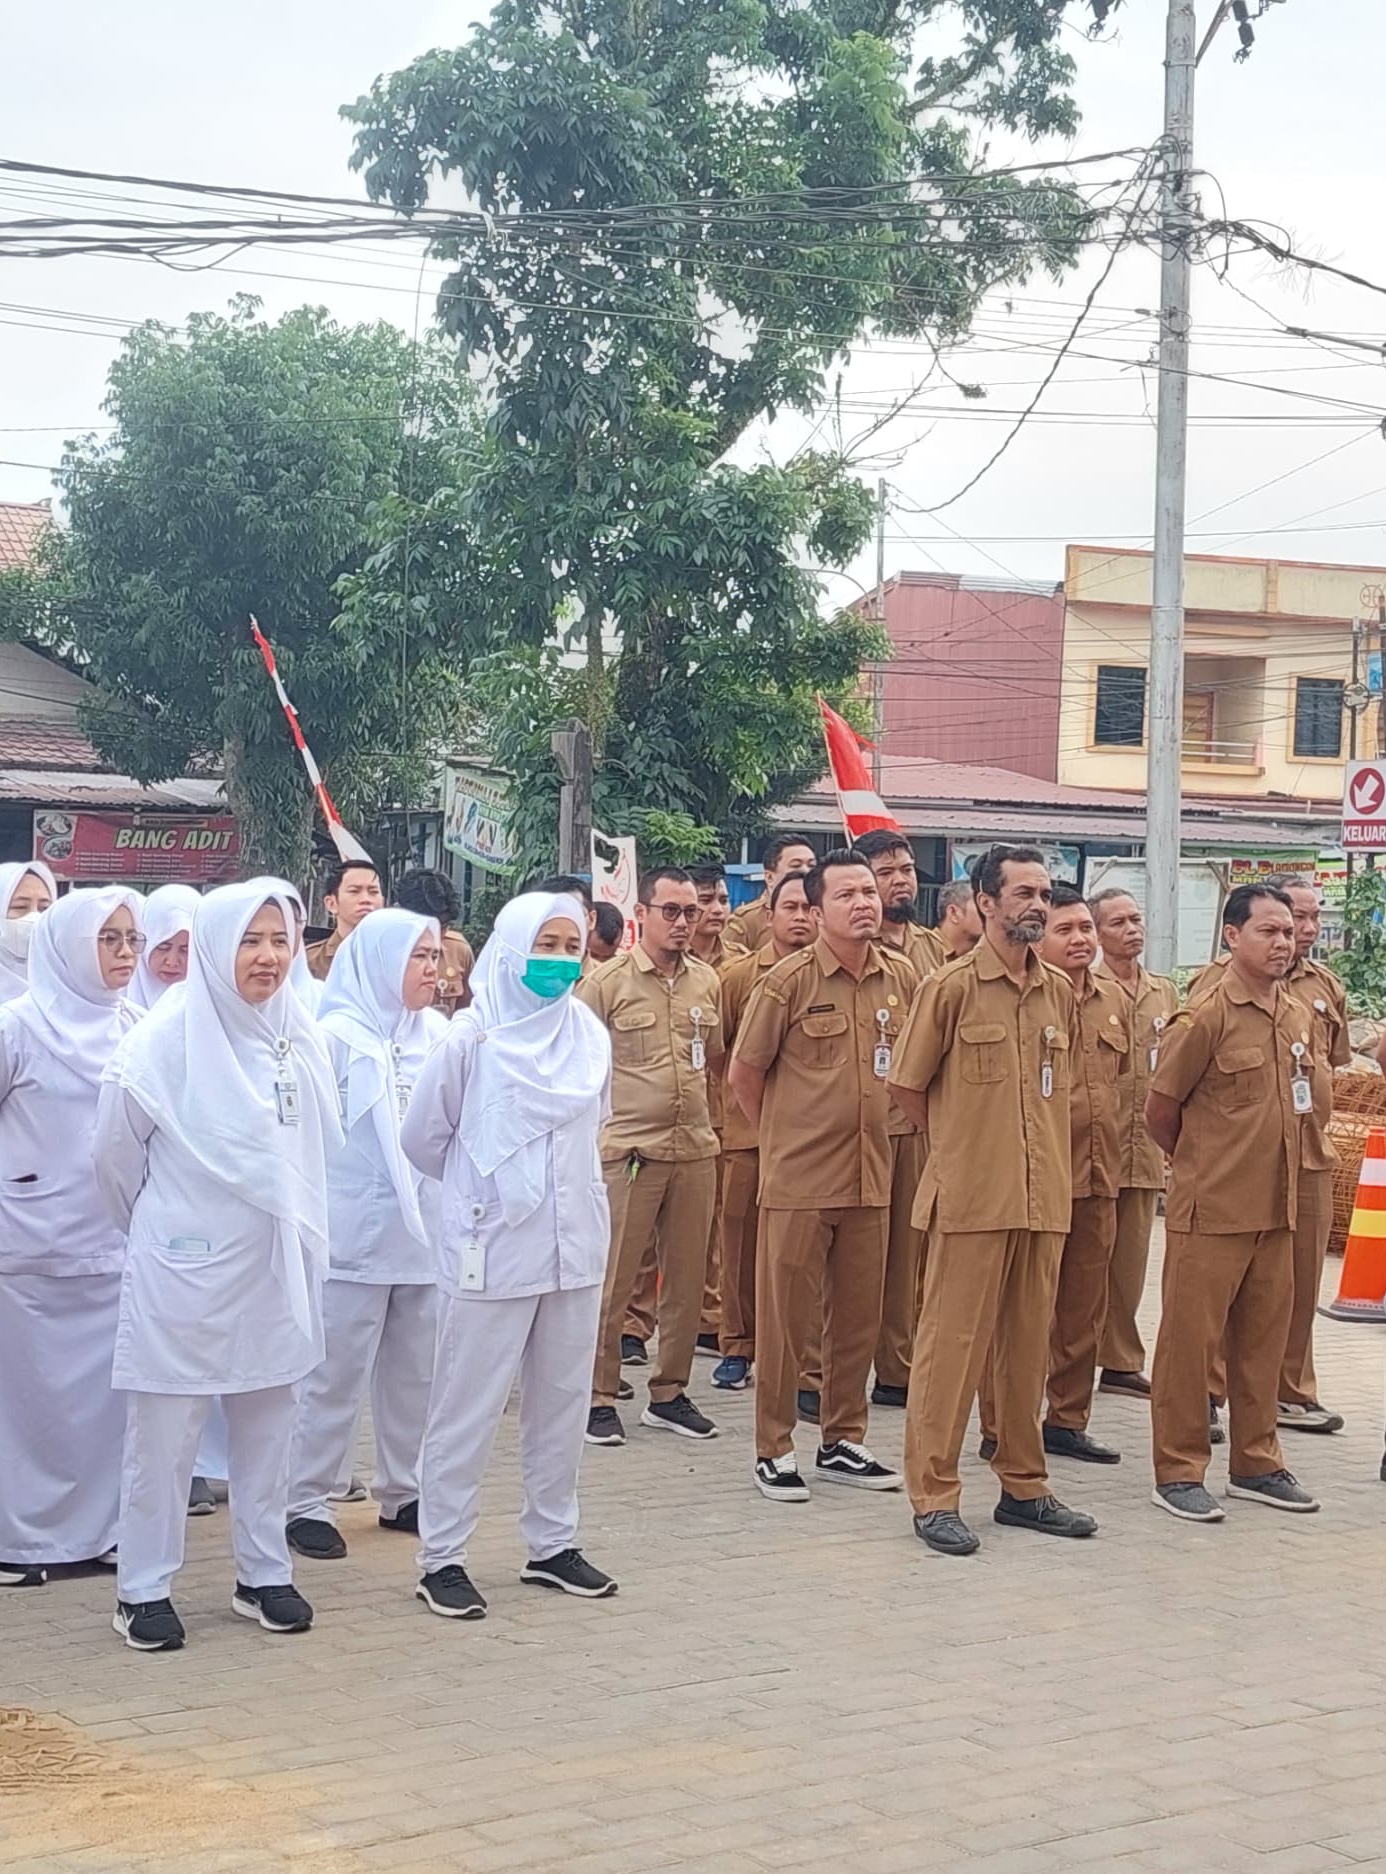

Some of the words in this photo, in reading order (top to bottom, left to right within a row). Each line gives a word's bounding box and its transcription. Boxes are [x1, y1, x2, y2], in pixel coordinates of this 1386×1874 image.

[116, 828, 177, 850] BANG
[182, 830, 233, 850] ADIT
[1343, 825, 1386, 841] KELUAR
